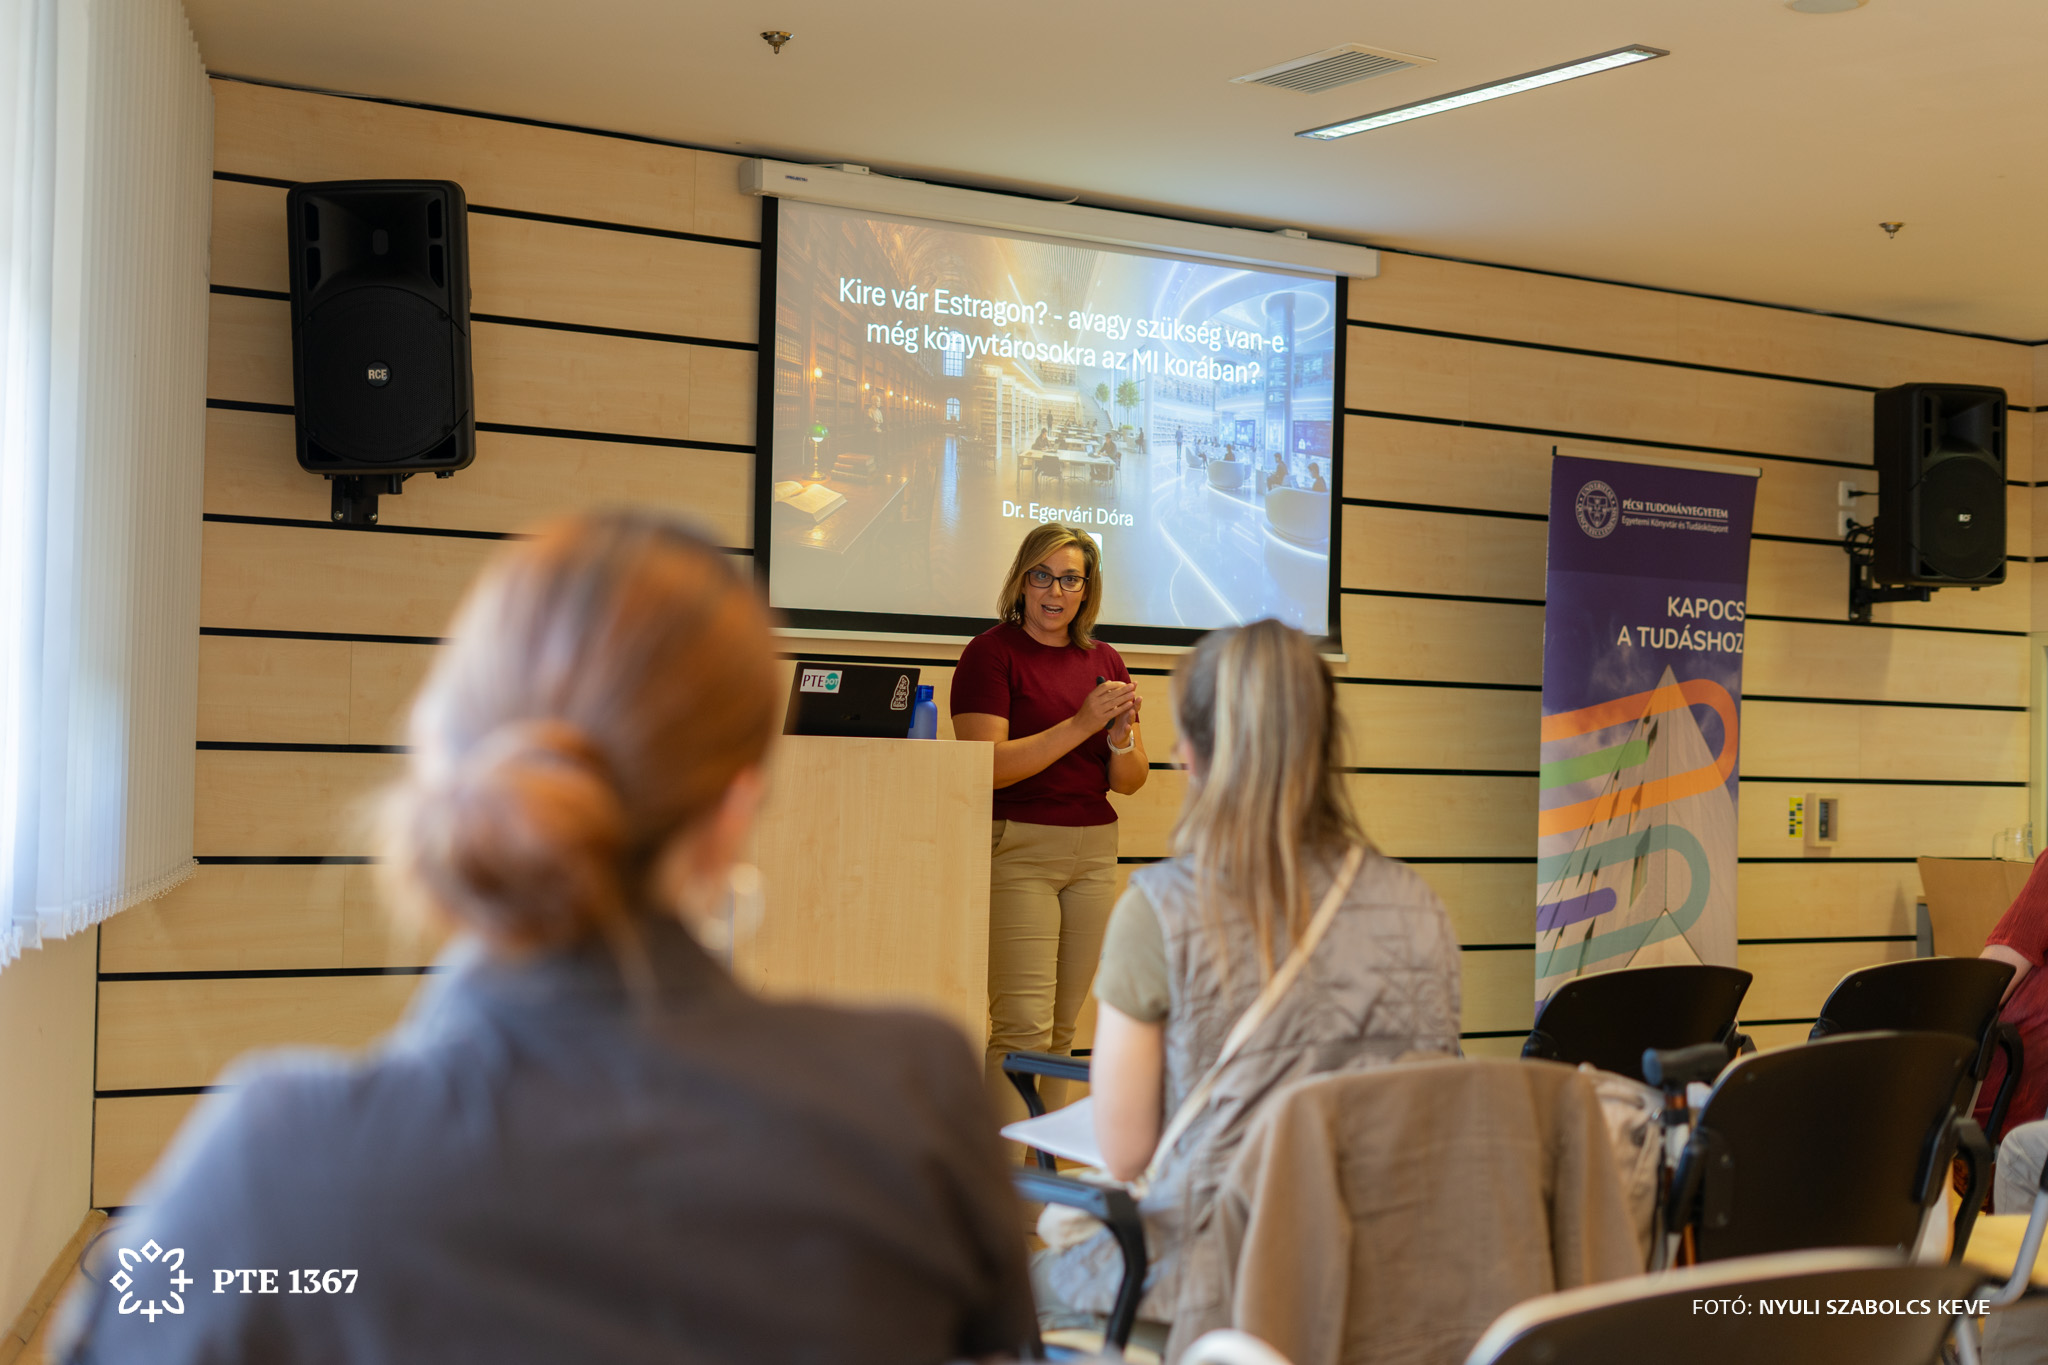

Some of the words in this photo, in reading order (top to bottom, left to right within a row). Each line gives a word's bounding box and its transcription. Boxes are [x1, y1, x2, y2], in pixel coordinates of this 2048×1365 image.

[839, 277, 887, 307] Kire
[891, 284, 929, 312] vár
[934, 288, 1048, 327] Estragon?
[1068, 310, 1131, 340] avagy
[1136, 316, 1222, 352] szükség
[1225, 329, 1285, 353] van-e
[867, 320, 919, 353] még
[924, 324, 1096, 367] könyvtárosokra
[1102, 350, 1127, 370] az
[1132, 348, 1158, 374] MI
[1165, 352, 1261, 384] korában?
[1002, 500, 1025, 518] Dr.
[1029, 502, 1093, 524] Egervári
[1096, 508, 1134, 527] Dóra
[1621, 515, 1650, 527] Egyetemi
[1622, 498, 1644, 511] PÉCSI
[1645, 502, 1729, 519] TUDOMÁNYEGYETEM
[1667, 596, 1745, 622] KAPOCS
[1617, 625, 1632, 647] A
[1636, 624, 1744, 653] TUDÁSHOZ
[802, 674, 825, 688] PTE
